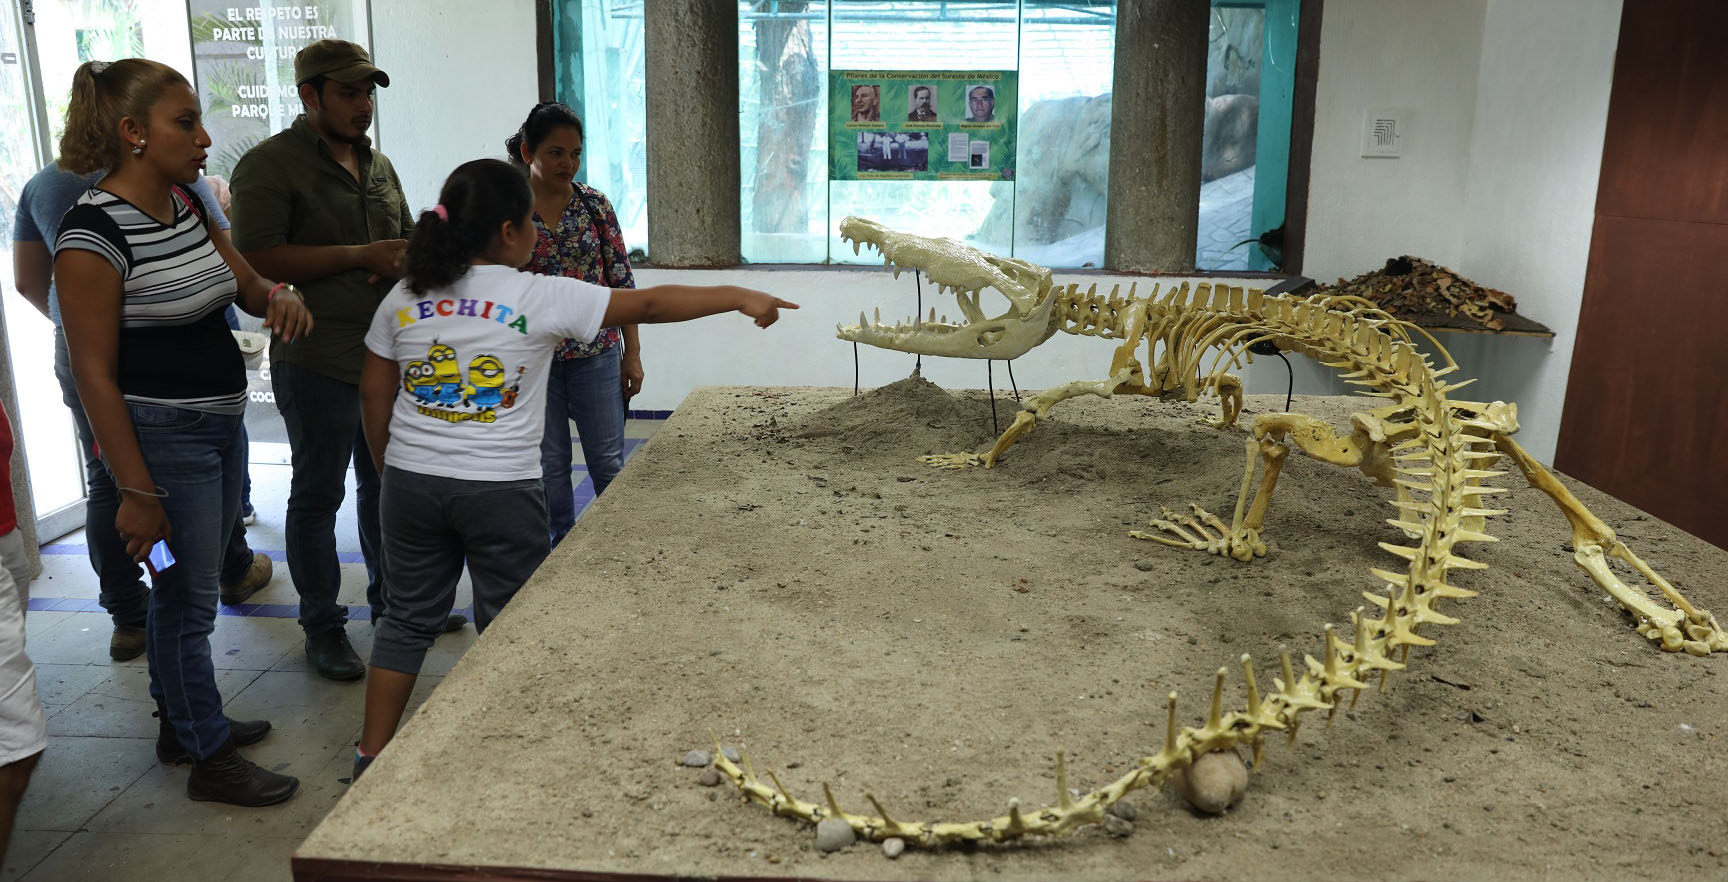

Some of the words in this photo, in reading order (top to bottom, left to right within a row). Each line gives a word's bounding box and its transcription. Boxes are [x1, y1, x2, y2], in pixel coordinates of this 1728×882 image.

[227, 8, 243, 21] EL
[246, 7, 301, 20] REPETO
[305, 6, 319, 20] ES
[213, 27, 256, 41] PARTE
[280, 25, 338, 40] NUESTRA
[246, 46, 304, 60] CUTUR
[238, 84, 299, 99] CUIDMO
[231, 103, 285, 120] PARQE
[396, 298, 529, 335] KECHITA
